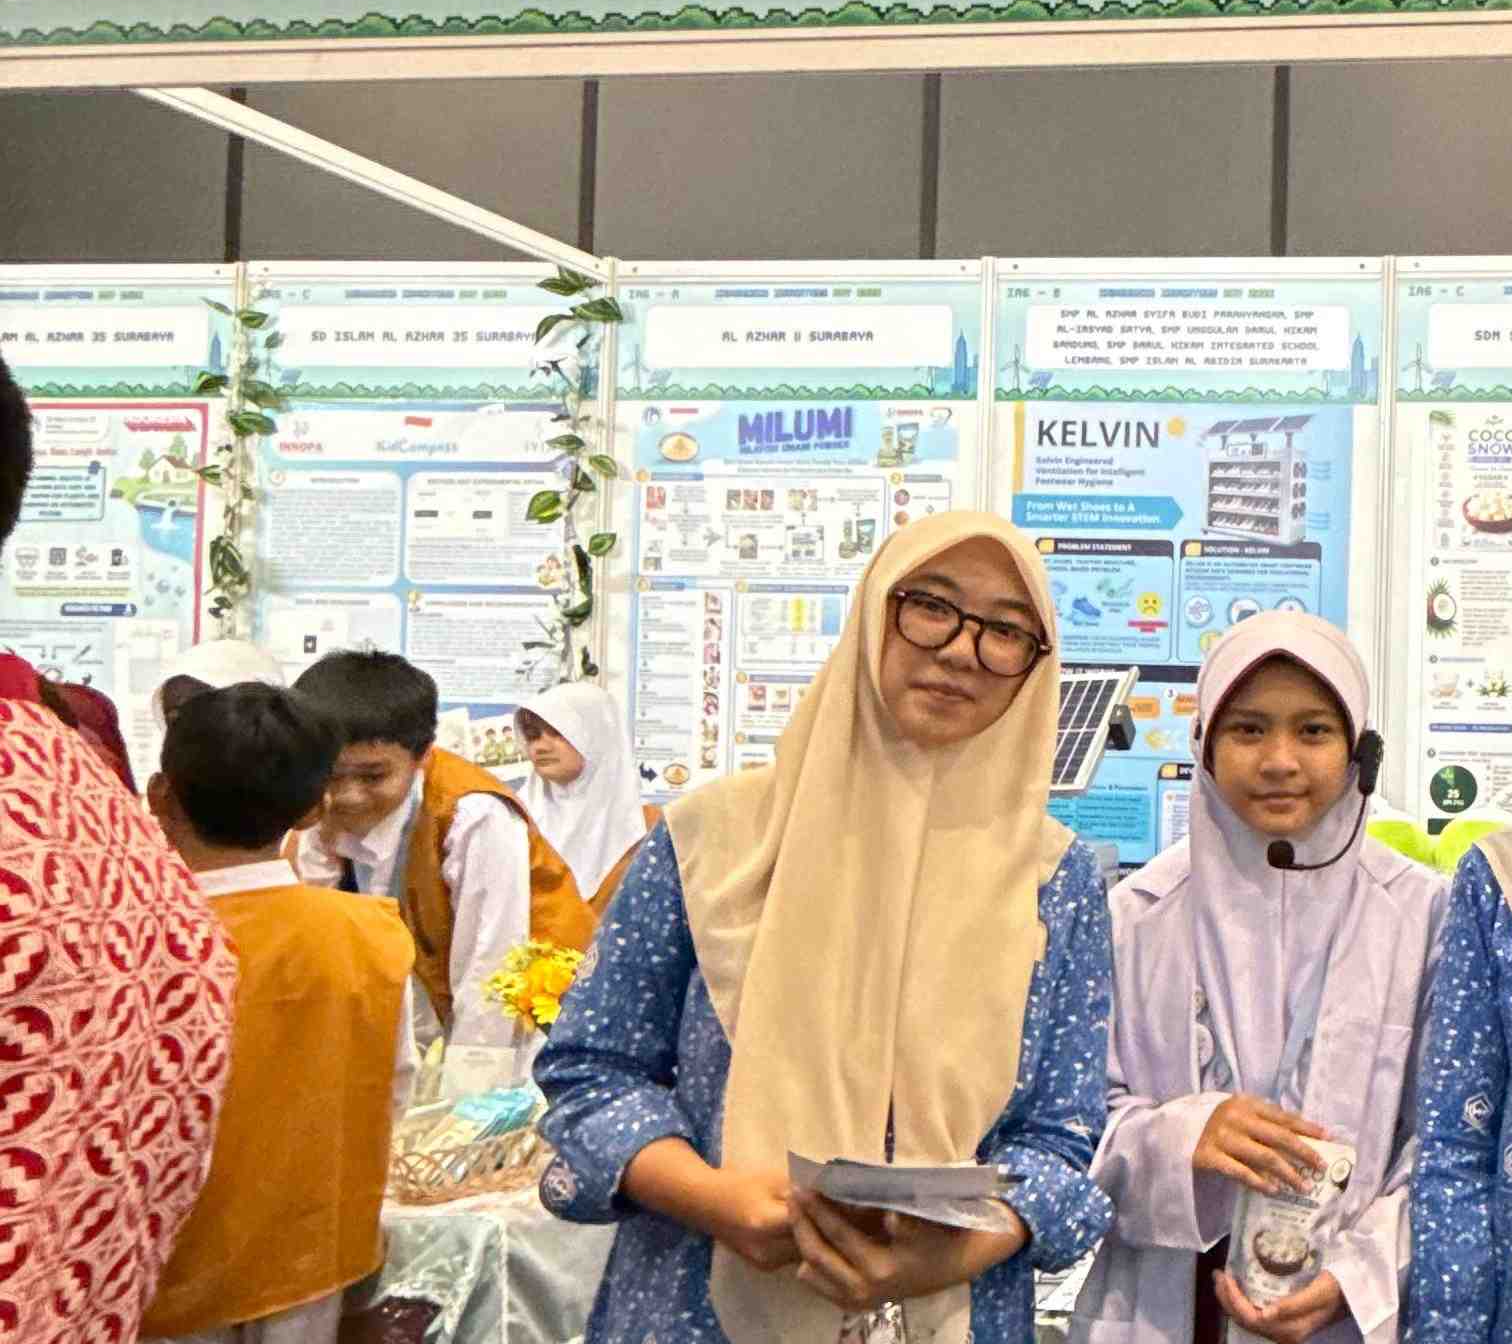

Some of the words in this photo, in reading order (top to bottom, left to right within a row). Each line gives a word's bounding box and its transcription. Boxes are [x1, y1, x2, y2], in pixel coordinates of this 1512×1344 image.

[1456, 286, 1465, 297] C
[1060, 309, 1081, 320] SMP
[1086, 309, 1100, 320] AL
[1105, 309, 1137, 320] AZHAR
[1143, 309, 1177, 320] SYIFA
[1181, 309, 1207, 320] BUDI
[1293, 309, 1315, 320] SMP
[721, 330, 738, 342] AL
[745, 330, 787, 342] AZHAR
[809, 330, 874, 342] SURABAYA
[1056, 324, 1114, 335] AL-IRSYAD
[1160, 325, 1181, 335] SMP
[1186, 325, 1239, 336] UNGGULAN
[1283, 325, 1318, 336] HIKAM
[113, 331, 174, 343] SURABAYA
[311, 331, 327, 342] SD
[334, 331, 375, 342] ISLAM
[382, 331, 398, 342] AL
[405, 331, 445, 342] AZHAR
[452, 331, 469, 342] 35
[1106, 340, 1127, 351] SMP
[1132, 340, 1164, 351] DARUL
[1170, 340, 1204, 351] HIKAM
[1210, 340, 1275, 352] INTEGRATED
[1119, 356, 1140, 366] SMP
[1145, 356, 1179, 366] ISLAM
[1184, 356, 1198, 366] AL
[1203, 356, 1243, 367] ABIDIN
[1248, 356, 1307, 367] SURAKARTA
[738, 406, 854, 445] MILUMI
[1036, 419, 1161, 449] KELVIN
[1035, 456, 1062, 466] Kelvin
[1064, 457, 1114, 468] Engineered
[1035, 467, 1079, 476] Ventilation
[1081, 467, 1098, 476] for
[1100, 467, 1145, 478] Intelligent
[1035, 477, 1074, 486] Footwear
[1077, 478, 1113, 488] Hygiene
[1025, 501, 1053, 511] From
[1055, 501, 1077, 511] Wet
[1079, 501, 1112, 512] Shoes
[1114, 502, 1126, 512] to
[1025, 512, 1070, 523] Smarter
[1071, 512, 1099, 523] STEM
[1100, 513, 1160, 524] Innovation
